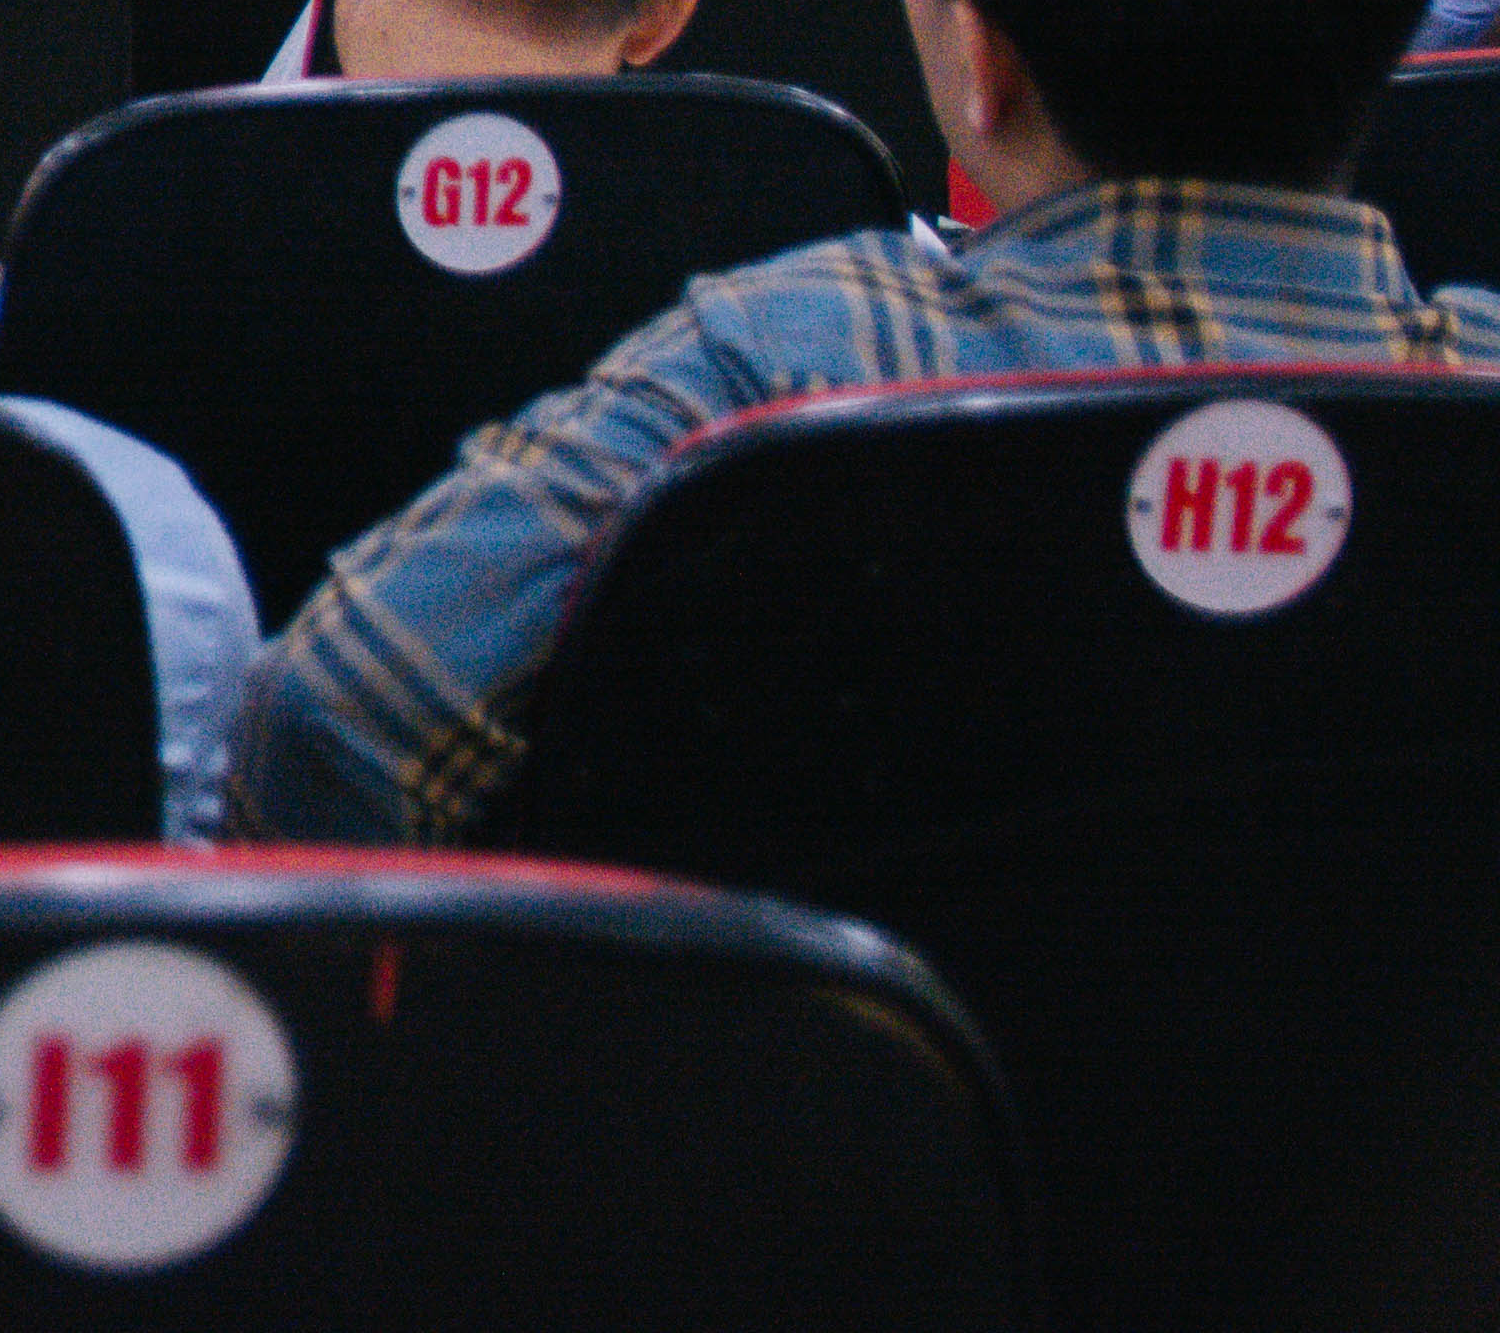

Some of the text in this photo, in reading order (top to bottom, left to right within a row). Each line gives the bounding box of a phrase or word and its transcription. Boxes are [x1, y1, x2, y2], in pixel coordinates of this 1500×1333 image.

[422, 157, 532, 228] G12
[1159, 457, 1314, 555] H12
[26, 1036, 225, 1175] I11
